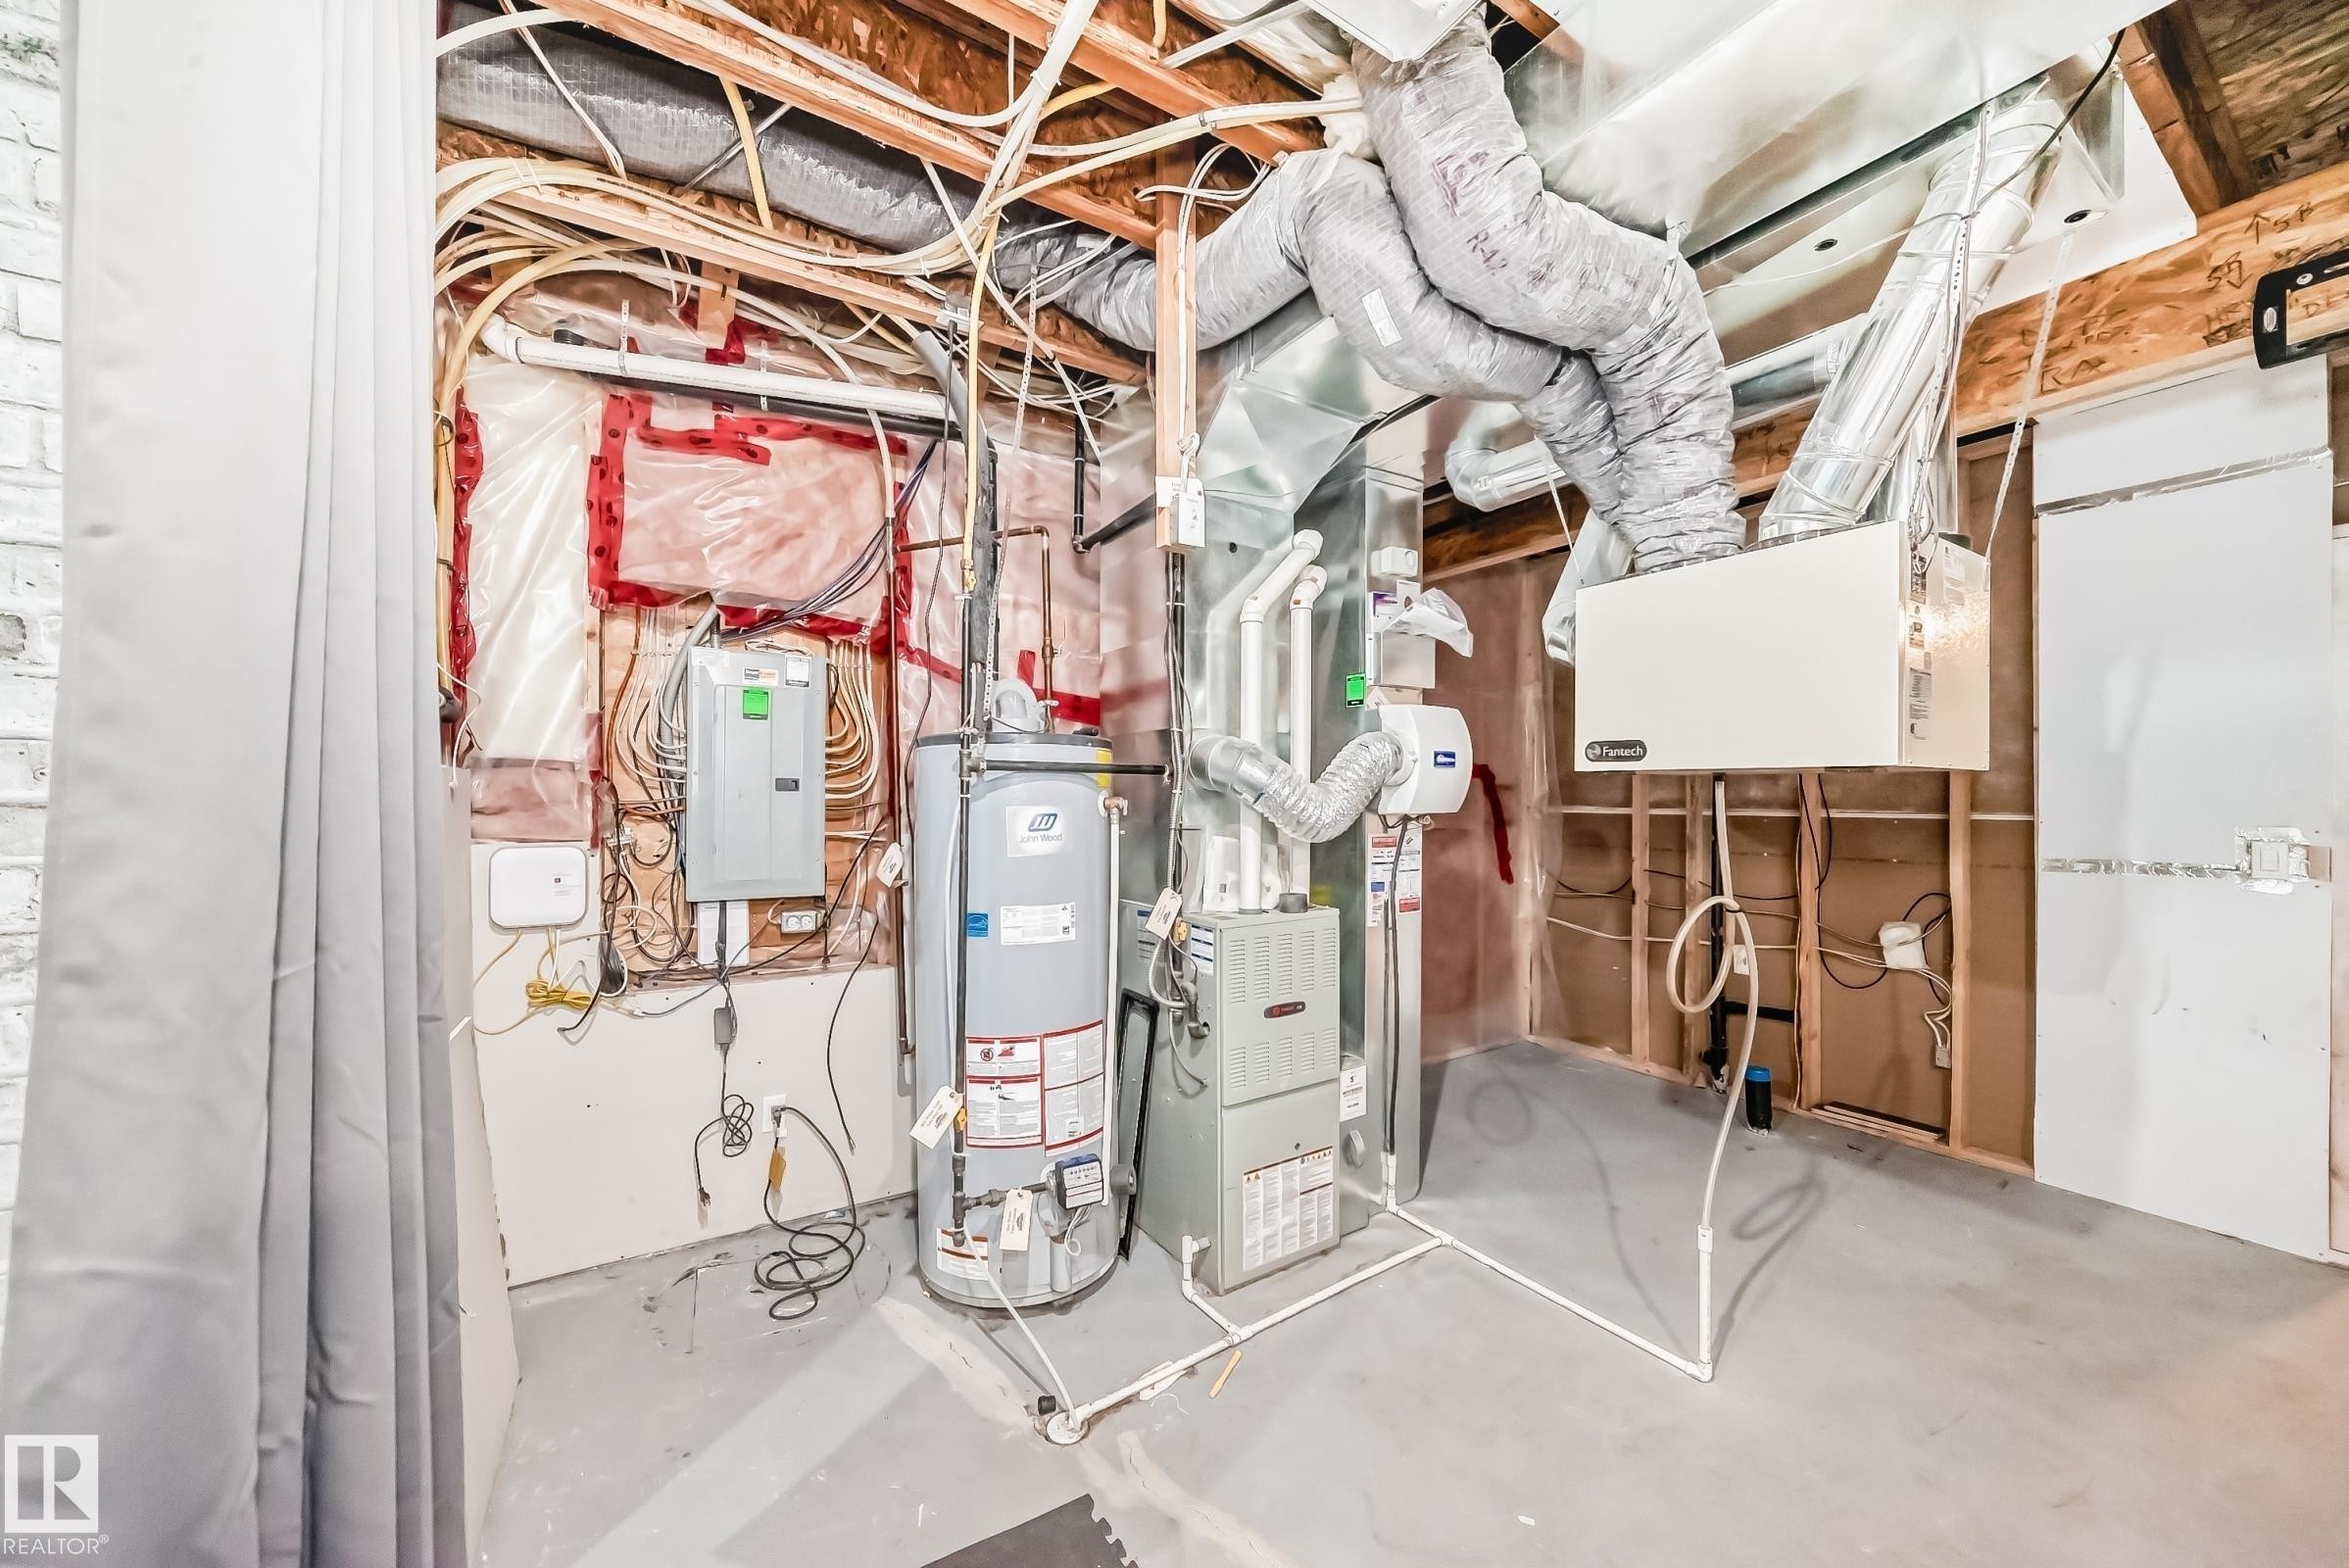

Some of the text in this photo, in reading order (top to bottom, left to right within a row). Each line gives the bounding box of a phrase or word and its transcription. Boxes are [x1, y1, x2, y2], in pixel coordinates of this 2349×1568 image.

[1602, 745, 1643, 758] Fantech
[1019, 832, 1063, 844] John Wood
